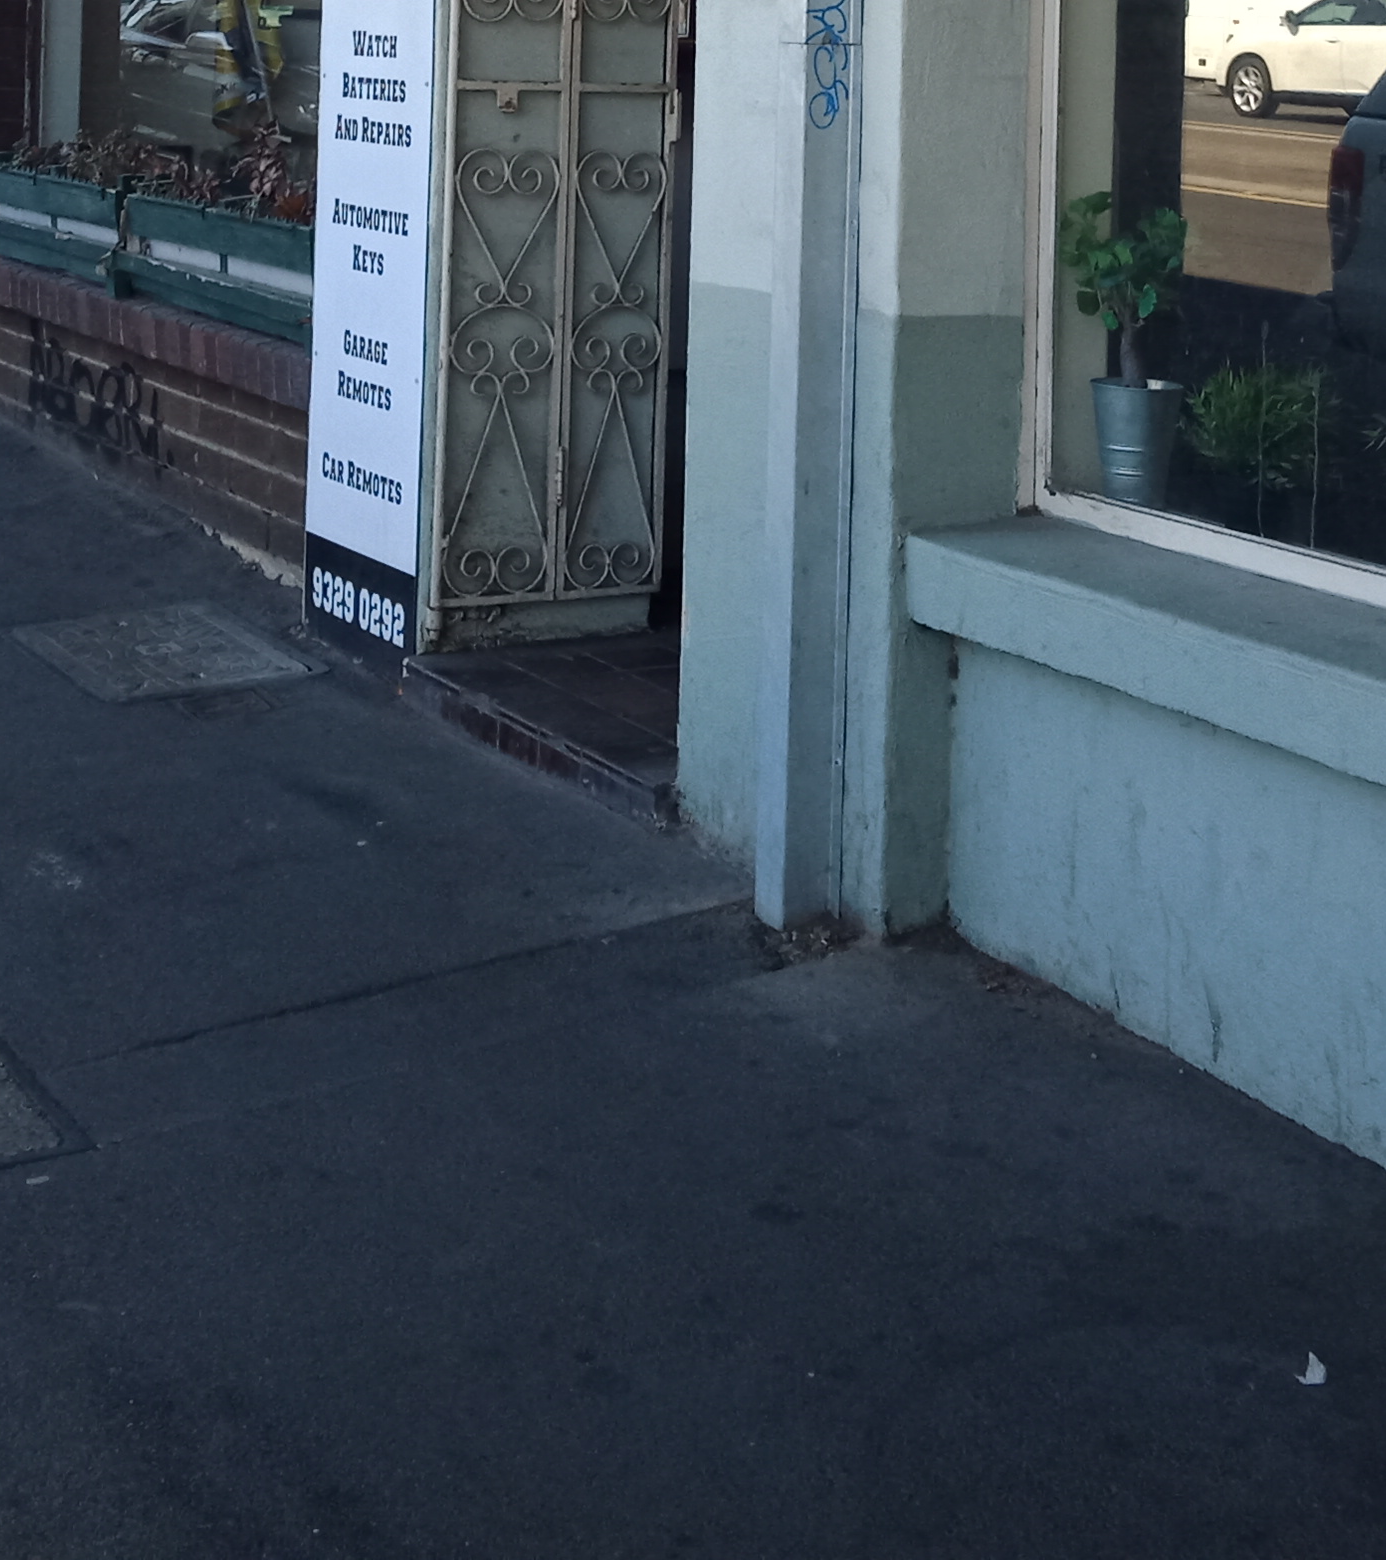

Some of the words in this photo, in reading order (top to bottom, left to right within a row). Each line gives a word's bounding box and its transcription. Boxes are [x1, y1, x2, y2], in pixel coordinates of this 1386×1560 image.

[352, 30, 398, 59] WATCH
[342, 72, 406, 103] BATTERIES
[335, 114, 359, 142] AND
[361, 117, 412, 148] REPAIRS
[332, 197, 409, 237] AUTOMOTIVE
[352, 244, 384, 277] KEYS
[343, 329, 389, 366] GARAGE
[337, 370, 392, 412] REMOTES
[322, 451, 345, 485] CAR
[347, 460, 402, 506] REMOTES
[312, 566, 355, 624] 9329
[358, 587, 405, 649] 0292
